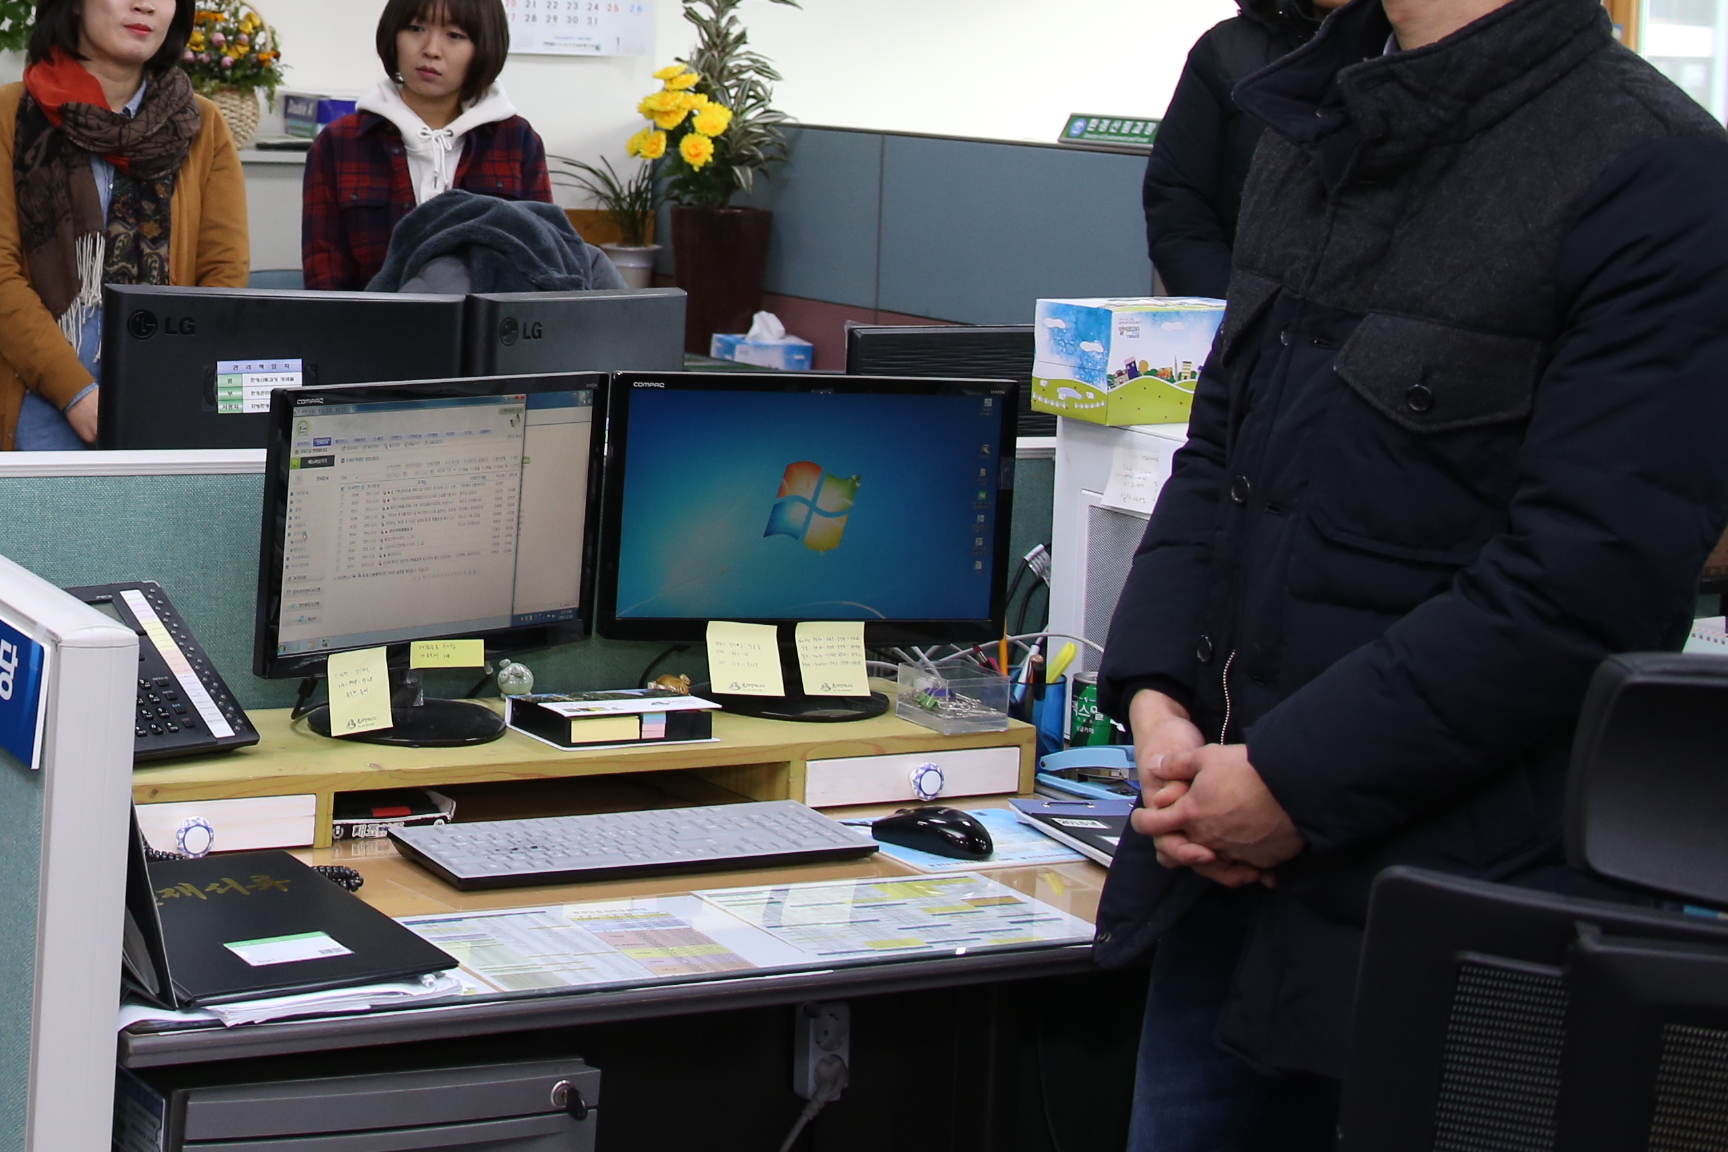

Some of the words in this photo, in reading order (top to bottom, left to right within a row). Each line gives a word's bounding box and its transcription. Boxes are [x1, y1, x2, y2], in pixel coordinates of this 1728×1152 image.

[165, 316, 196, 335] LG
[522, 321, 542, 339] LG
[155, 875, 291, 906] 재서류
